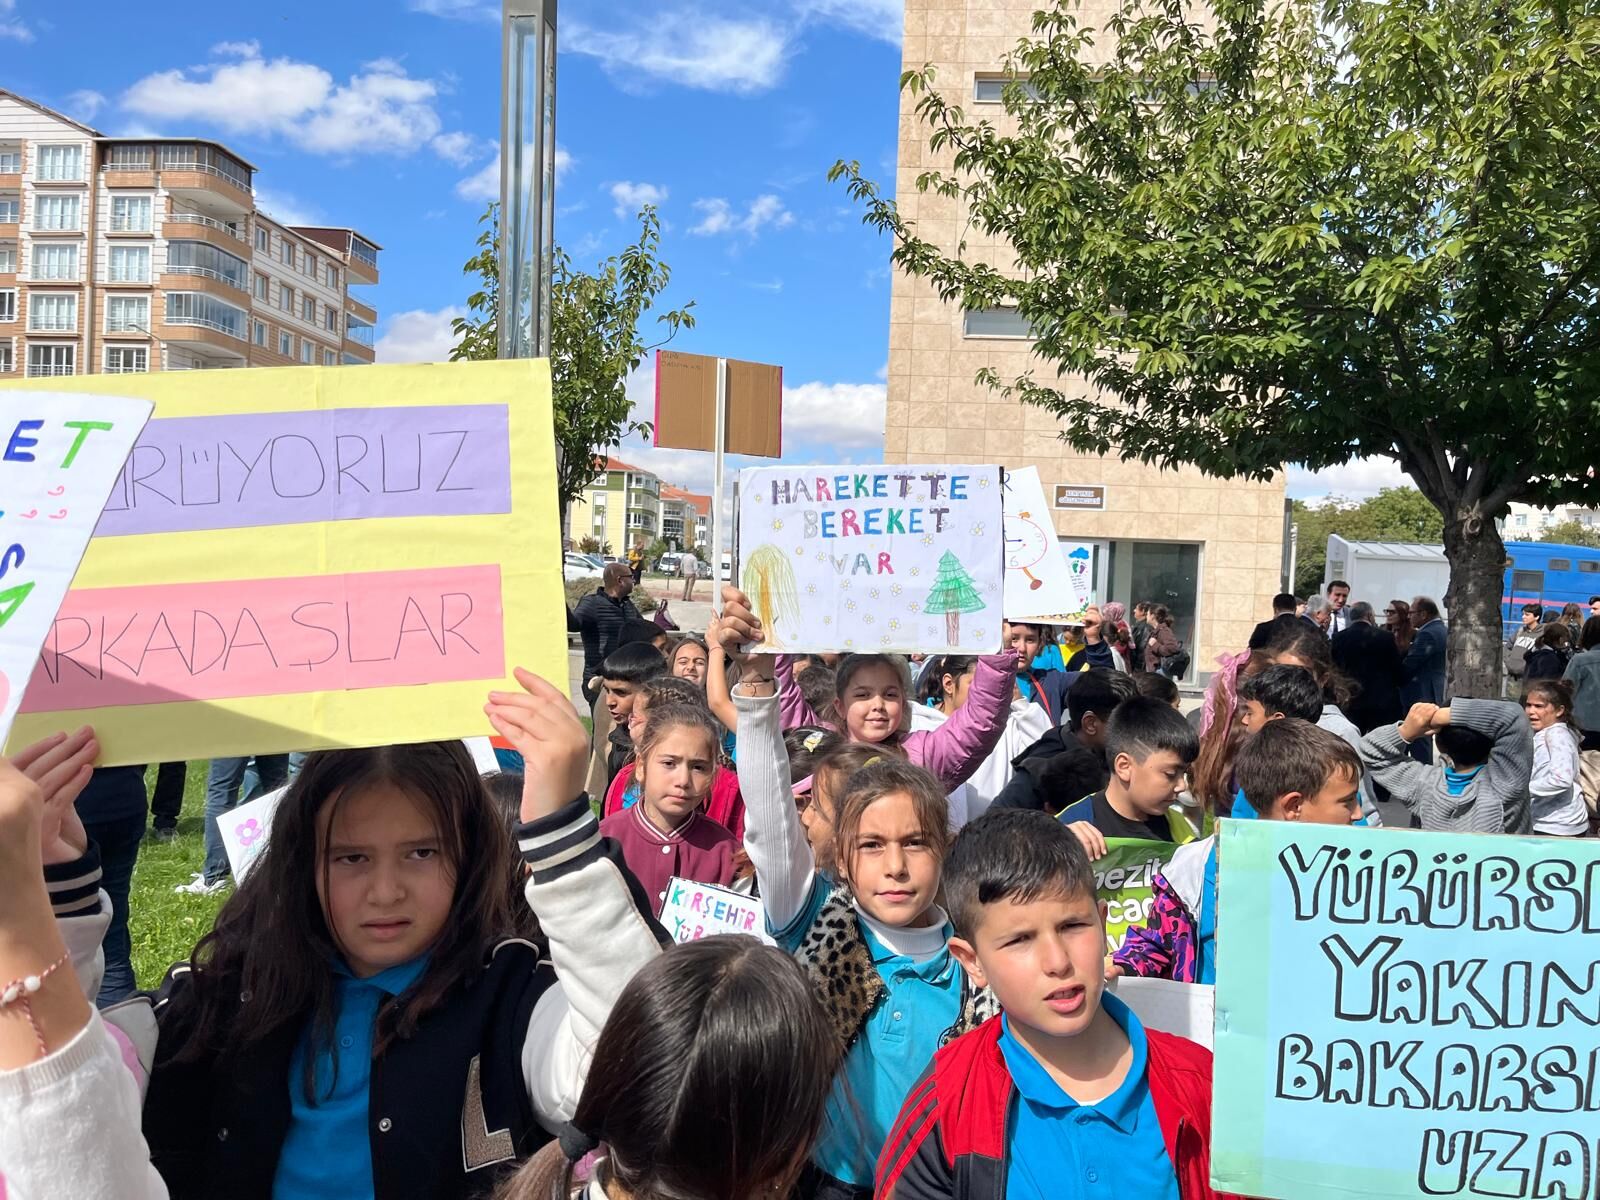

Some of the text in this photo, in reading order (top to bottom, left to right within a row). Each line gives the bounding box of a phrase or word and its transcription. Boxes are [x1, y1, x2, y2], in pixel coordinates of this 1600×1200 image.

[771, 473, 970, 506] HAREKETTE
[803, 507, 951, 539] BEREKET
[829, 551, 895, 576] VAR
[41, 592, 481, 684] RKADAŞLAR
[671, 884, 757, 931] KIRŞEHİR
[1275, 1033, 1600, 1113] BAKARS
[1417, 1127, 1600, 1200] UZA
